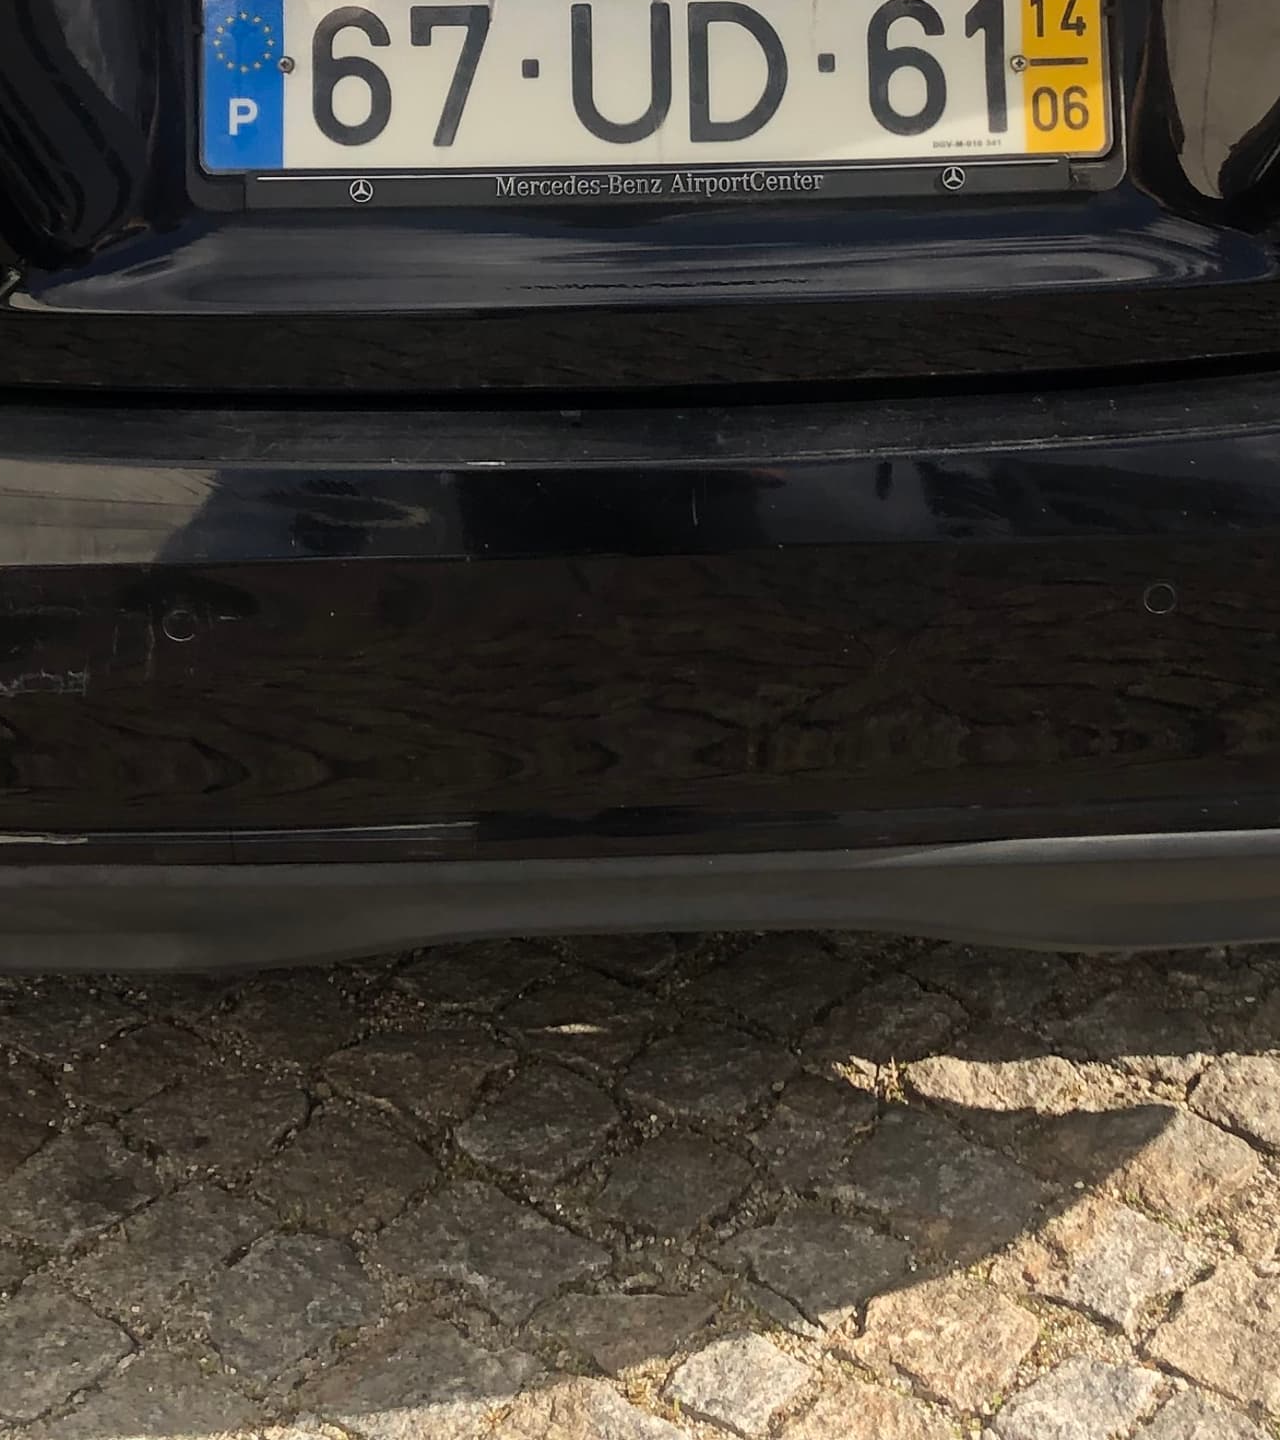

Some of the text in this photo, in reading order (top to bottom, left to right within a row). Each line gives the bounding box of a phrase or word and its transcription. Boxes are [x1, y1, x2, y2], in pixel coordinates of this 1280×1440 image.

[228, 98, 257, 135] P
[1031, 86, 1089, 131] 06
[495, 171, 823, 197] Mercedes-Benz AirportCenter
